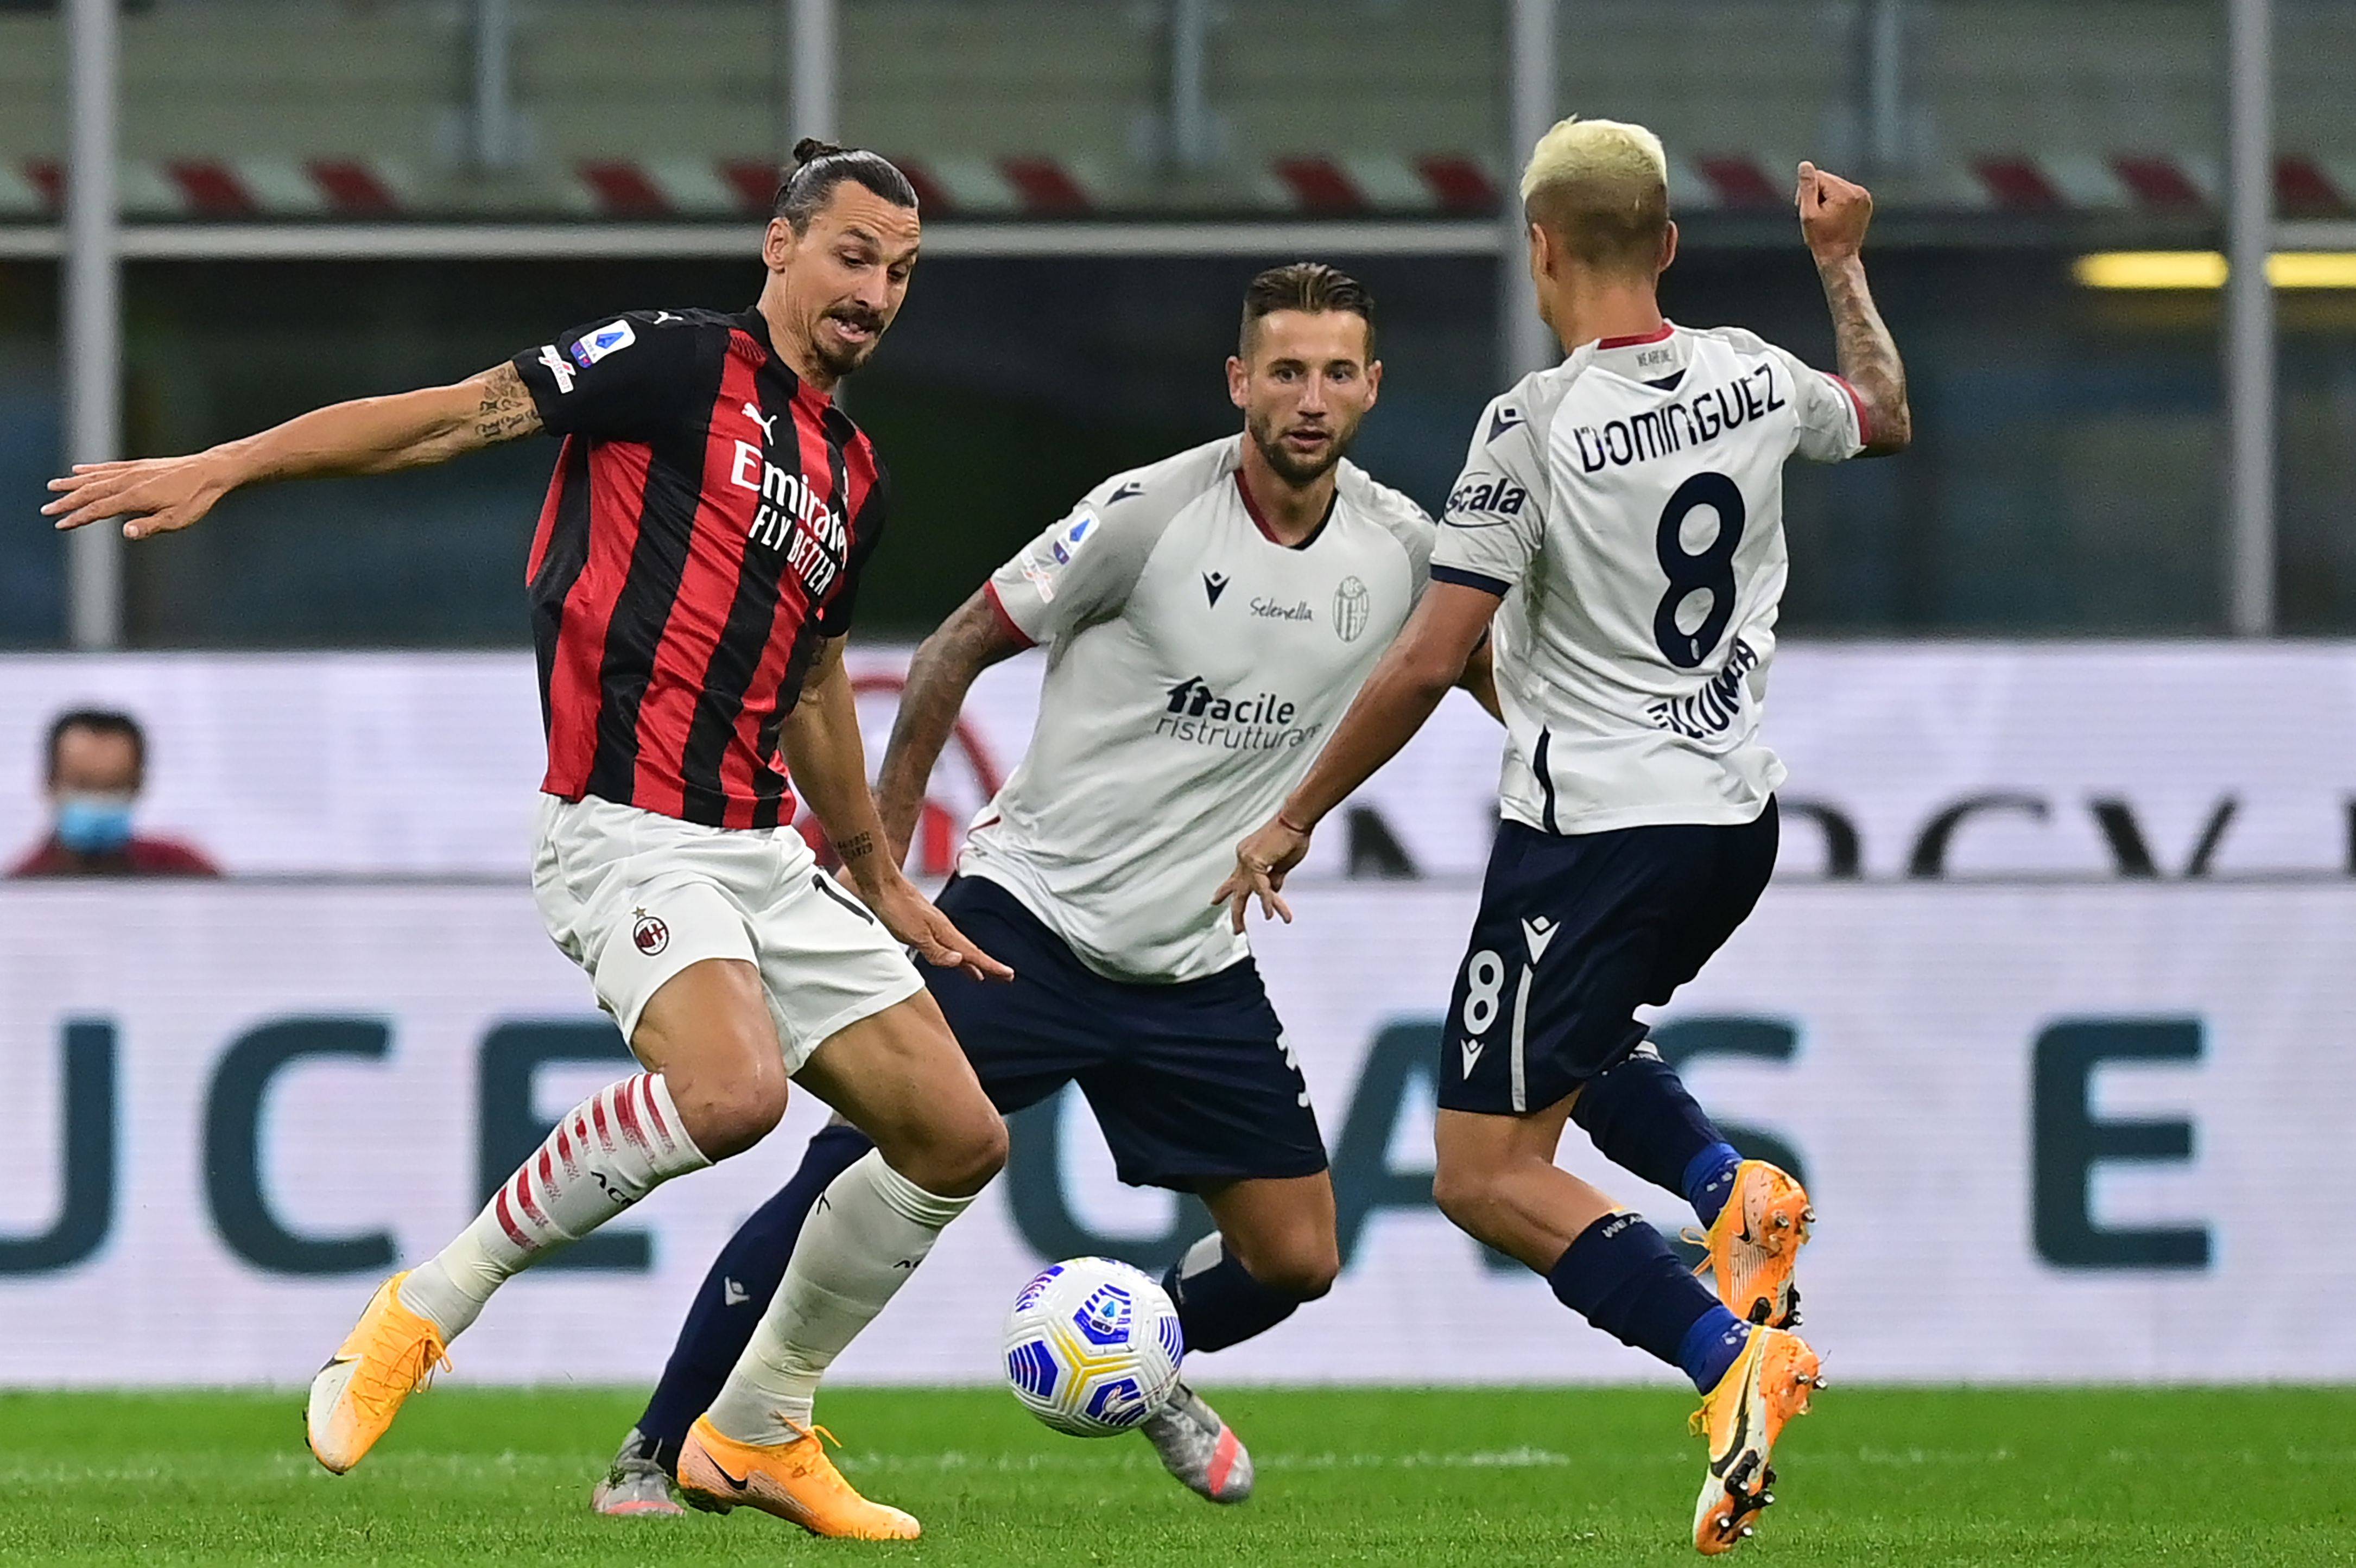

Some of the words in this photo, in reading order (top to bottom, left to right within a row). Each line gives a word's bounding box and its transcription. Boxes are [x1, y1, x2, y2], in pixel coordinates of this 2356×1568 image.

[748, 504, 792, 551] FLY
[787, 527, 836, 596] BETTER
[1654, 472, 1745, 669] 8
[1250, 596, 1313, 621] Selenella
[1463, 949, 1505, 1035] 8
[2029, 1015, 2214, 1273] E
